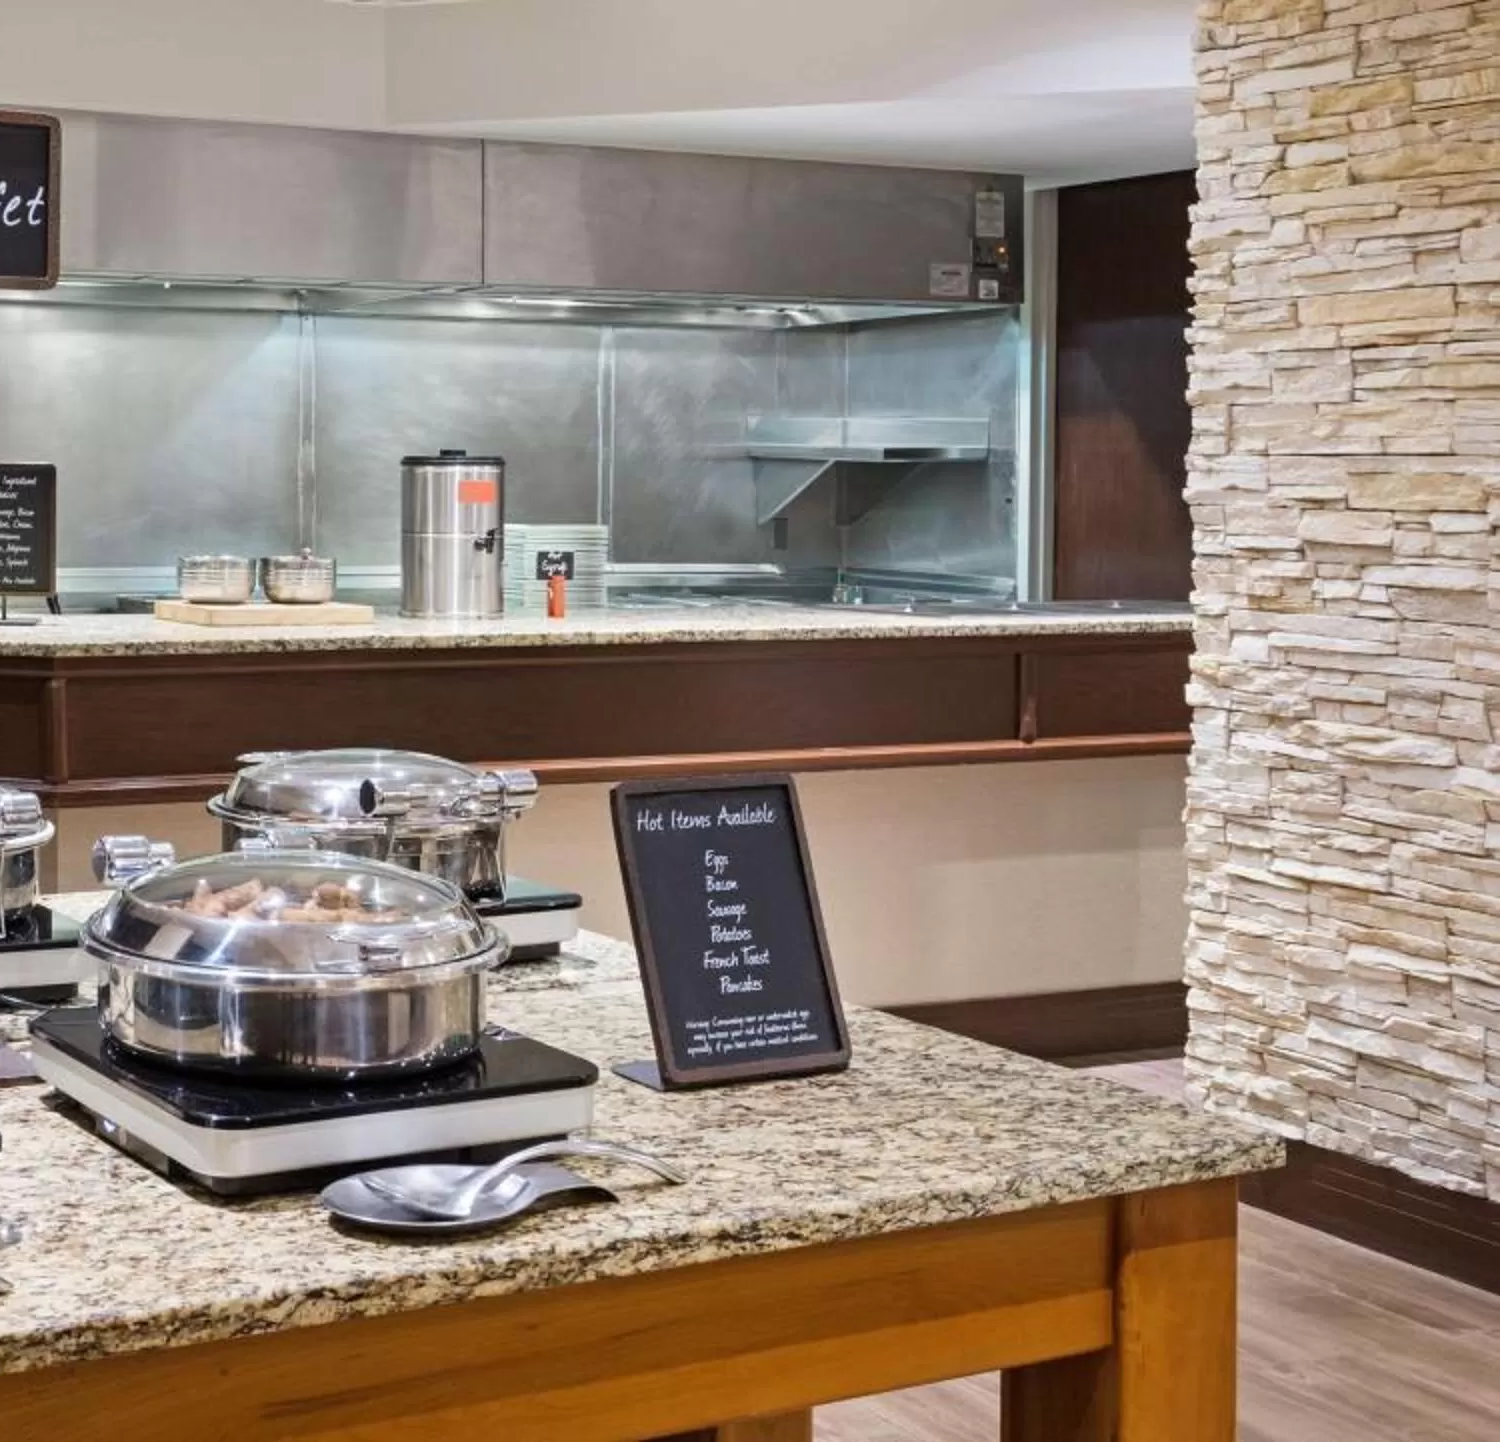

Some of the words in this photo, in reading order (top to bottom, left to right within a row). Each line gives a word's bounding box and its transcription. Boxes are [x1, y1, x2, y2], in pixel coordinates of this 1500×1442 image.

[636, 809, 664, 832] Hot
[671, 808, 711, 829] Items
[717, 801, 777, 826] Available
[705, 849, 729, 875] Eggs
[705, 876, 738, 892] Bacon
[708, 899, 748, 924] Sausage
[710, 925, 752, 943] Potatoes
[703, 950, 739, 970] French
[740, 945, 770, 965] Toast
[719, 974, 763, 995] Pancakes
